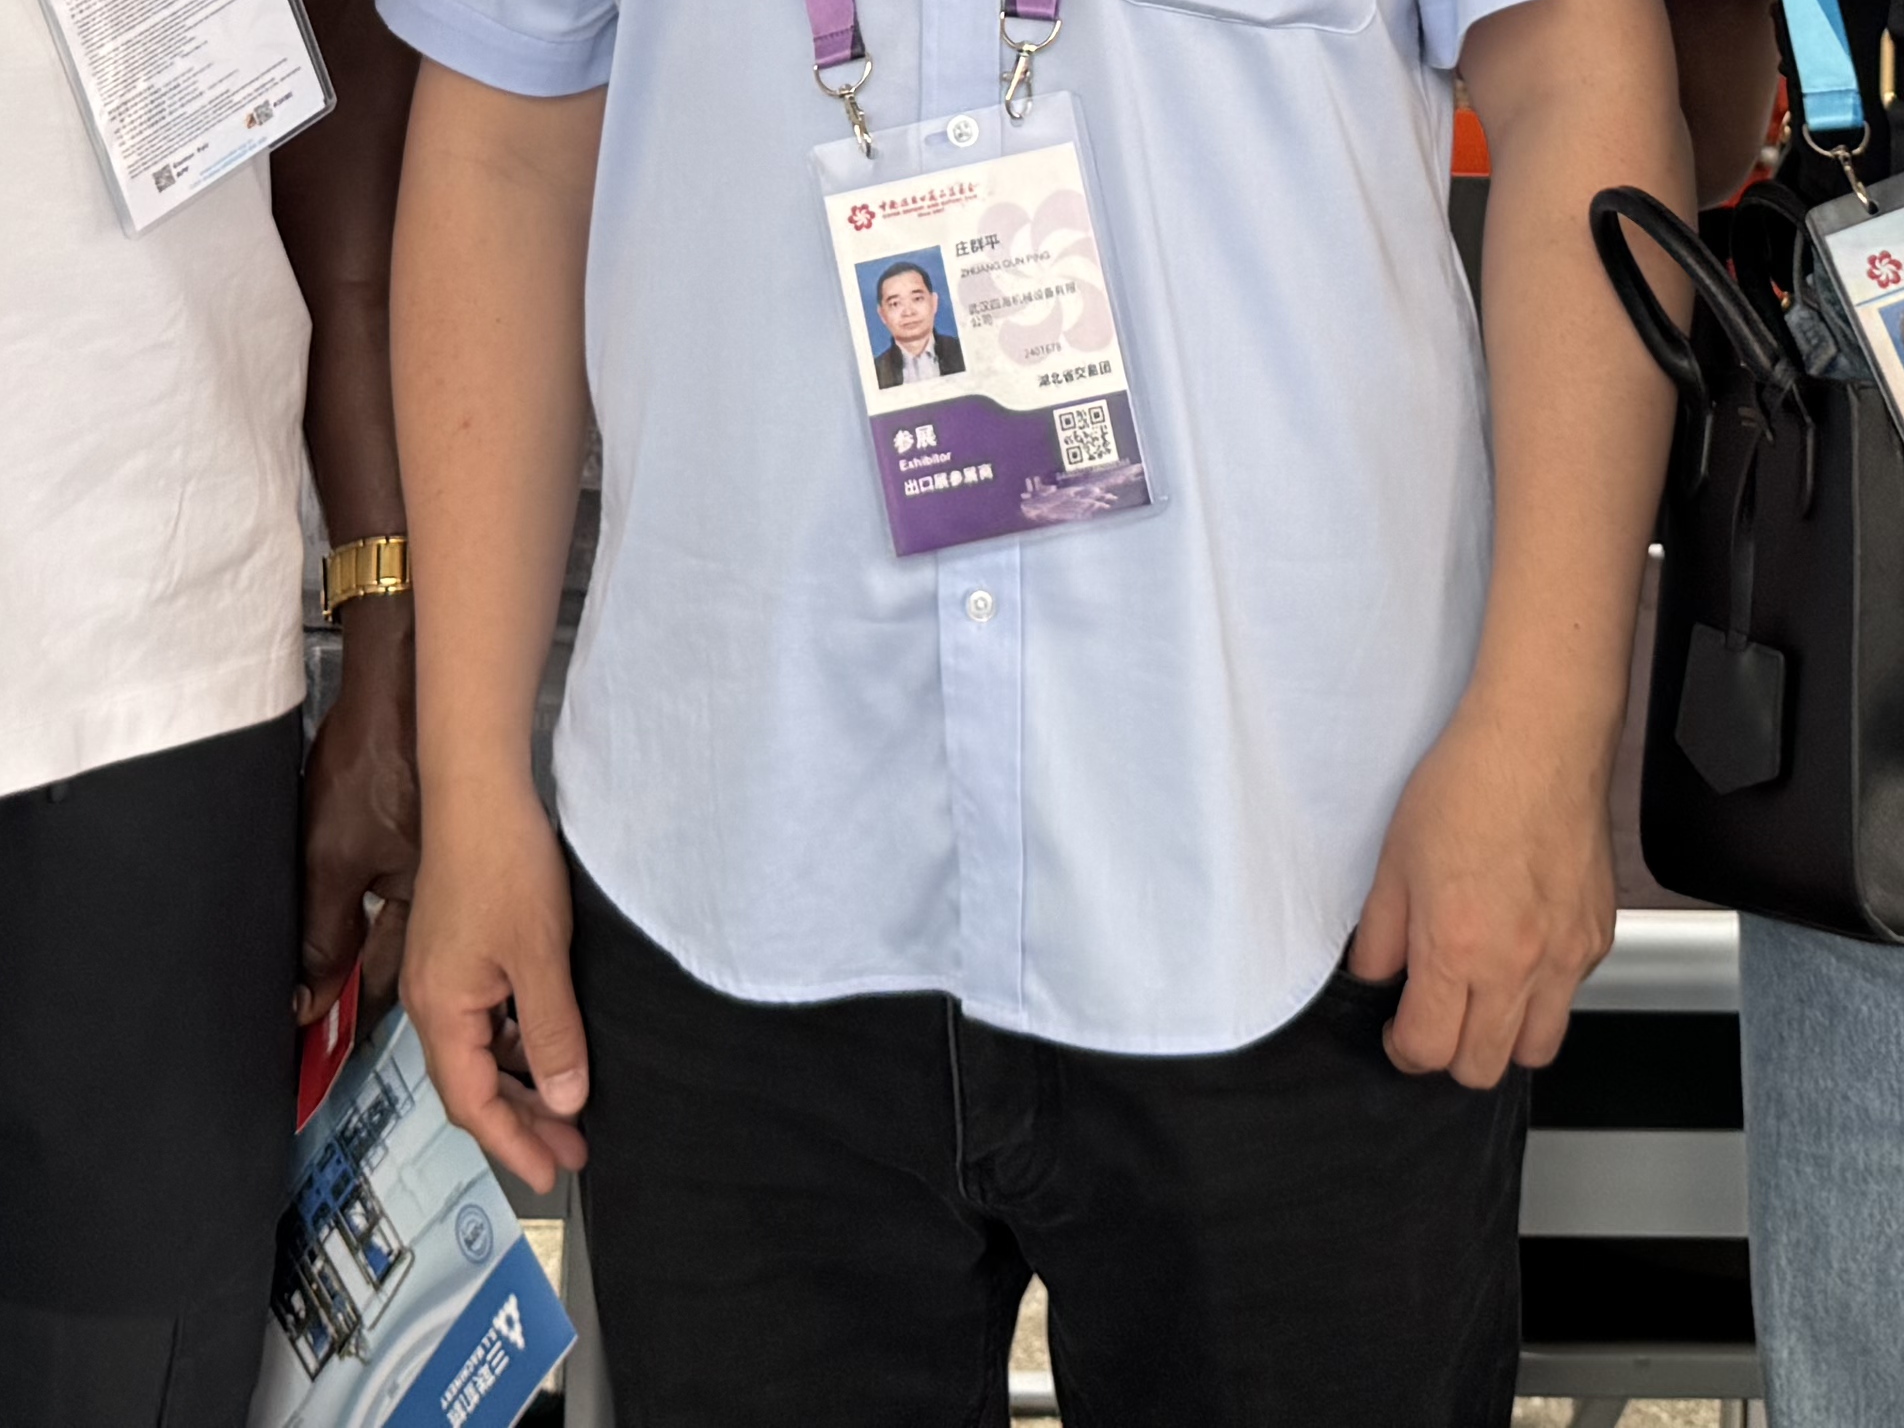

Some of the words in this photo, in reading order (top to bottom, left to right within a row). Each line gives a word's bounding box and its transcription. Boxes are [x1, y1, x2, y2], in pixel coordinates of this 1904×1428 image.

[959, 260, 1000, 278] ZHUANG
[891, 423, 938, 454] 参展
[898, 449, 952, 472] Exhibitor
